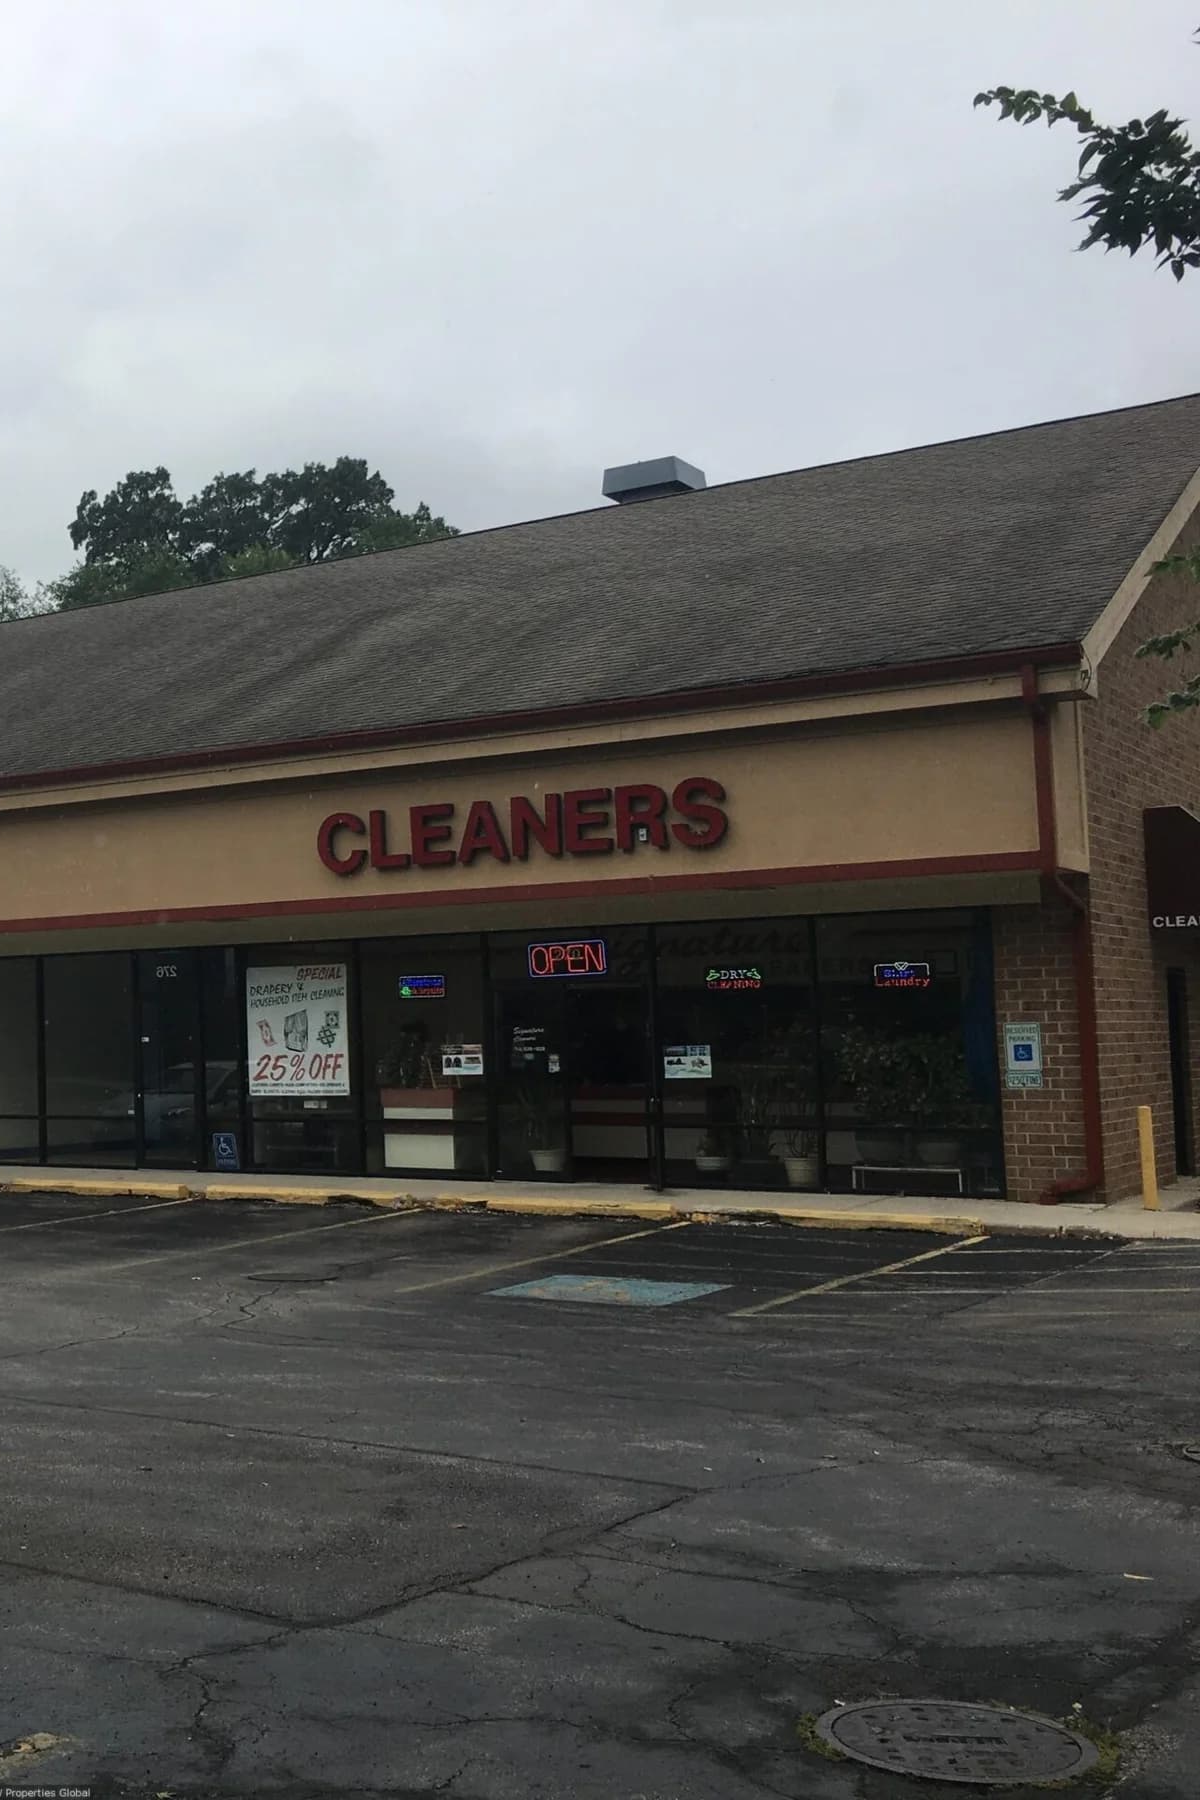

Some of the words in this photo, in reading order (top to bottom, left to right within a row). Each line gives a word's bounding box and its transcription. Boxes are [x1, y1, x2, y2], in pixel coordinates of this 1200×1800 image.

[316, 777, 729, 875] CLEANERS
[1153, 915, 1200, 928] CLEA
[531, 943, 604, 975] OPEN
[296, 967, 343, 981] SPECIAL
[720, 969, 748, 980] DRY
[250, 983, 292, 996] DRAPERY
[250, 996, 290, 1008] HOUSEHOLD
[311, 987, 344, 1001] CLEANING
[253, 1054, 305, 1081] 25%
[309, 1053, 344, 1080] OFF
